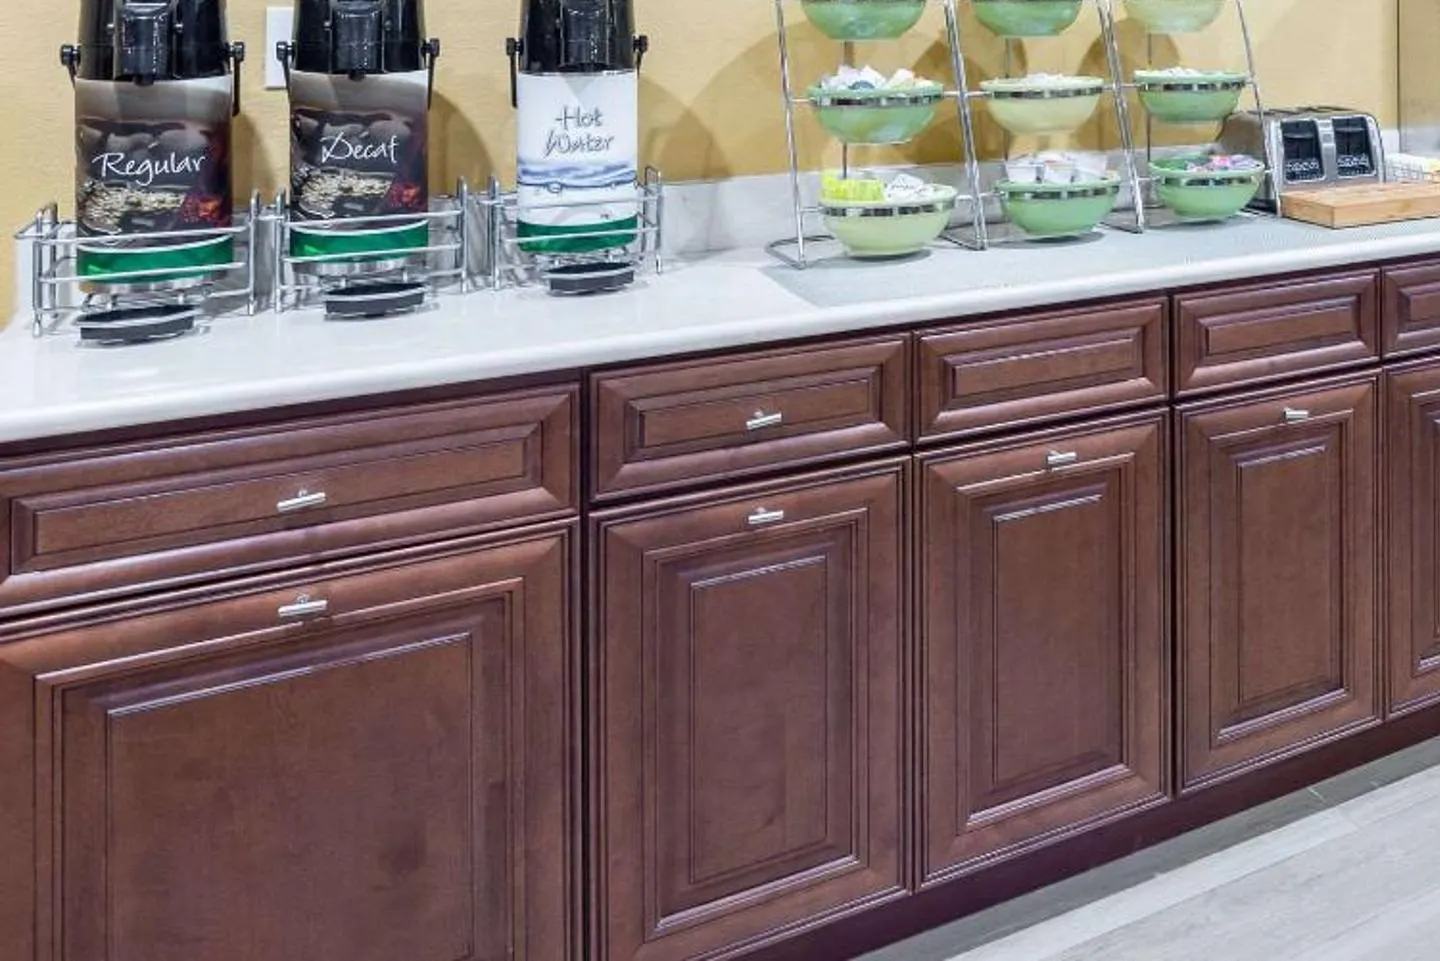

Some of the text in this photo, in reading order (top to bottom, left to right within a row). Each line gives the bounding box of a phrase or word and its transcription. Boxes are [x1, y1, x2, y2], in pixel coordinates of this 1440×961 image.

[555, 106, 602, 130] Hot
[320, 131, 399, 164] Decaf
[543, 130, 615, 157] Water
[92, 152, 206, 186] Regular
